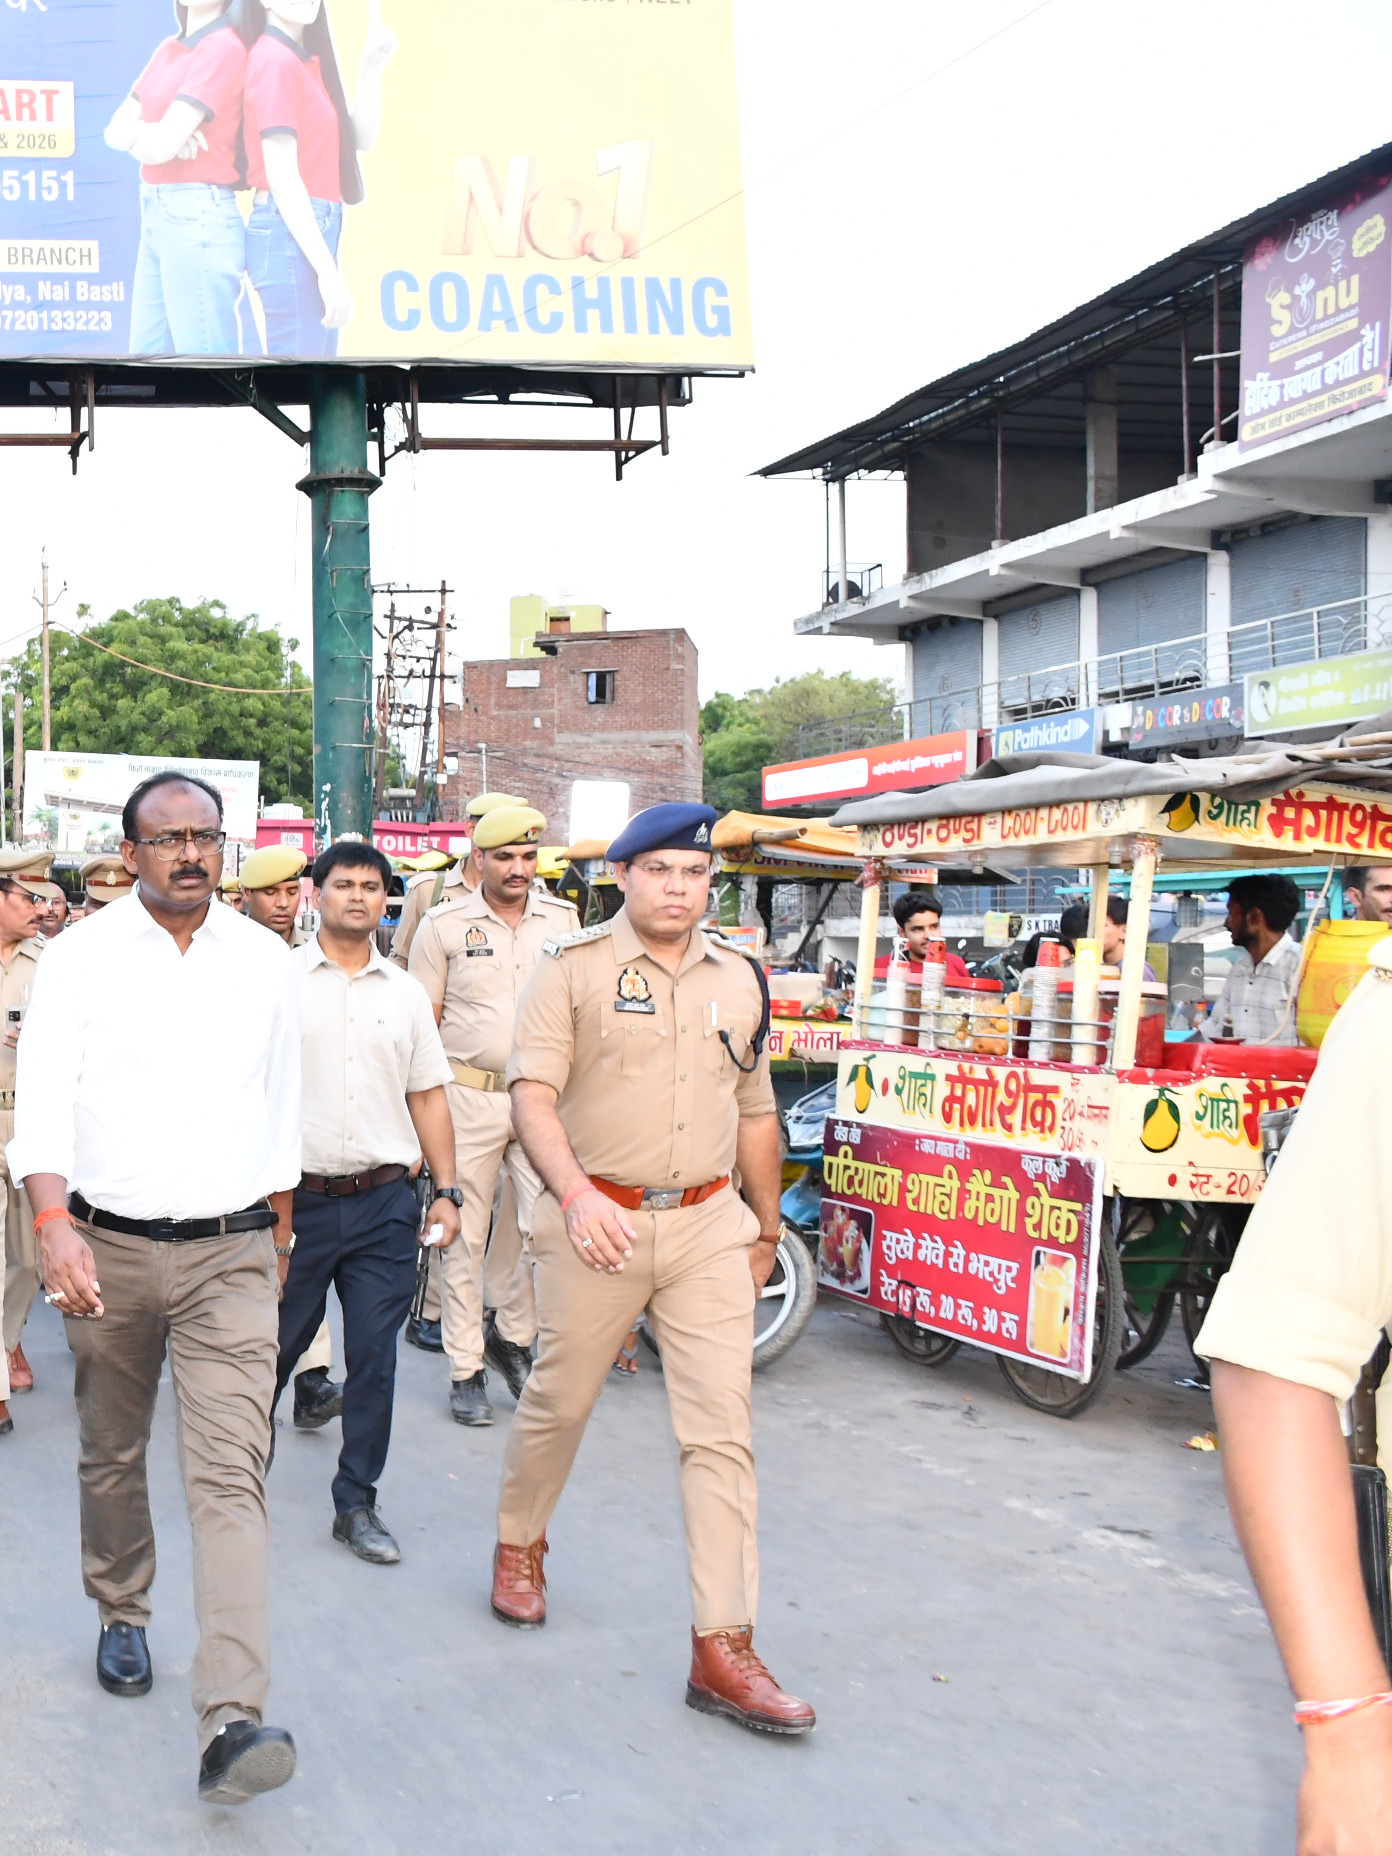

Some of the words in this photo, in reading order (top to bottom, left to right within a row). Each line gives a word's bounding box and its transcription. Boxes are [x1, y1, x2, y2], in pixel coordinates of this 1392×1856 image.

[16, 134, 57, 150] 2026
[442, 138, 656, 262] No.1
[7, 247, 93, 267] BRANCH
[38, 282, 69, 301] Nai
[76, 283, 125, 301] Basti
[379, 270, 732, 337] COACHING
[1282, 365, 1323, 401] स्वागत
[1324, 341, 1360, 385] करता
[1145, 704, 1181, 730] DECOR
[1191, 697, 1230, 723] DECOR
[1014, 719, 1071, 750] Pathkind
[373, 834, 440, 852] TOILET
[1027, 920, 1032, 931] S
[1034, 920, 1040, 931] K
[1043, 920, 1060, 931] TRA
[894, 1062, 937, 1119] शाही
[1195, 1082, 1239, 1139] शाही
[921, 1138, 935, 1155] जय
[936, 1140, 954, 1158] माता
[956, 1139, 966, 1160] दी
[1021, 1154, 1044, 1180] कूल
[823, 1144, 903, 1207] पटियाला
[905, 1163, 960, 1221] शाही
[963, 1168, 1020, 1234] मैंगो
[1024, 1182, 1083, 1244] शेक
[917, 1232, 946, 1270] मेवे
[947, 1240, 967, 1275] से
[879, 1269, 898, 1302] रेट
[898, 1287, 912, 1313] 15
[939, 1293, 955, 1320] 20
[981, 1306, 998, 1334] 30
